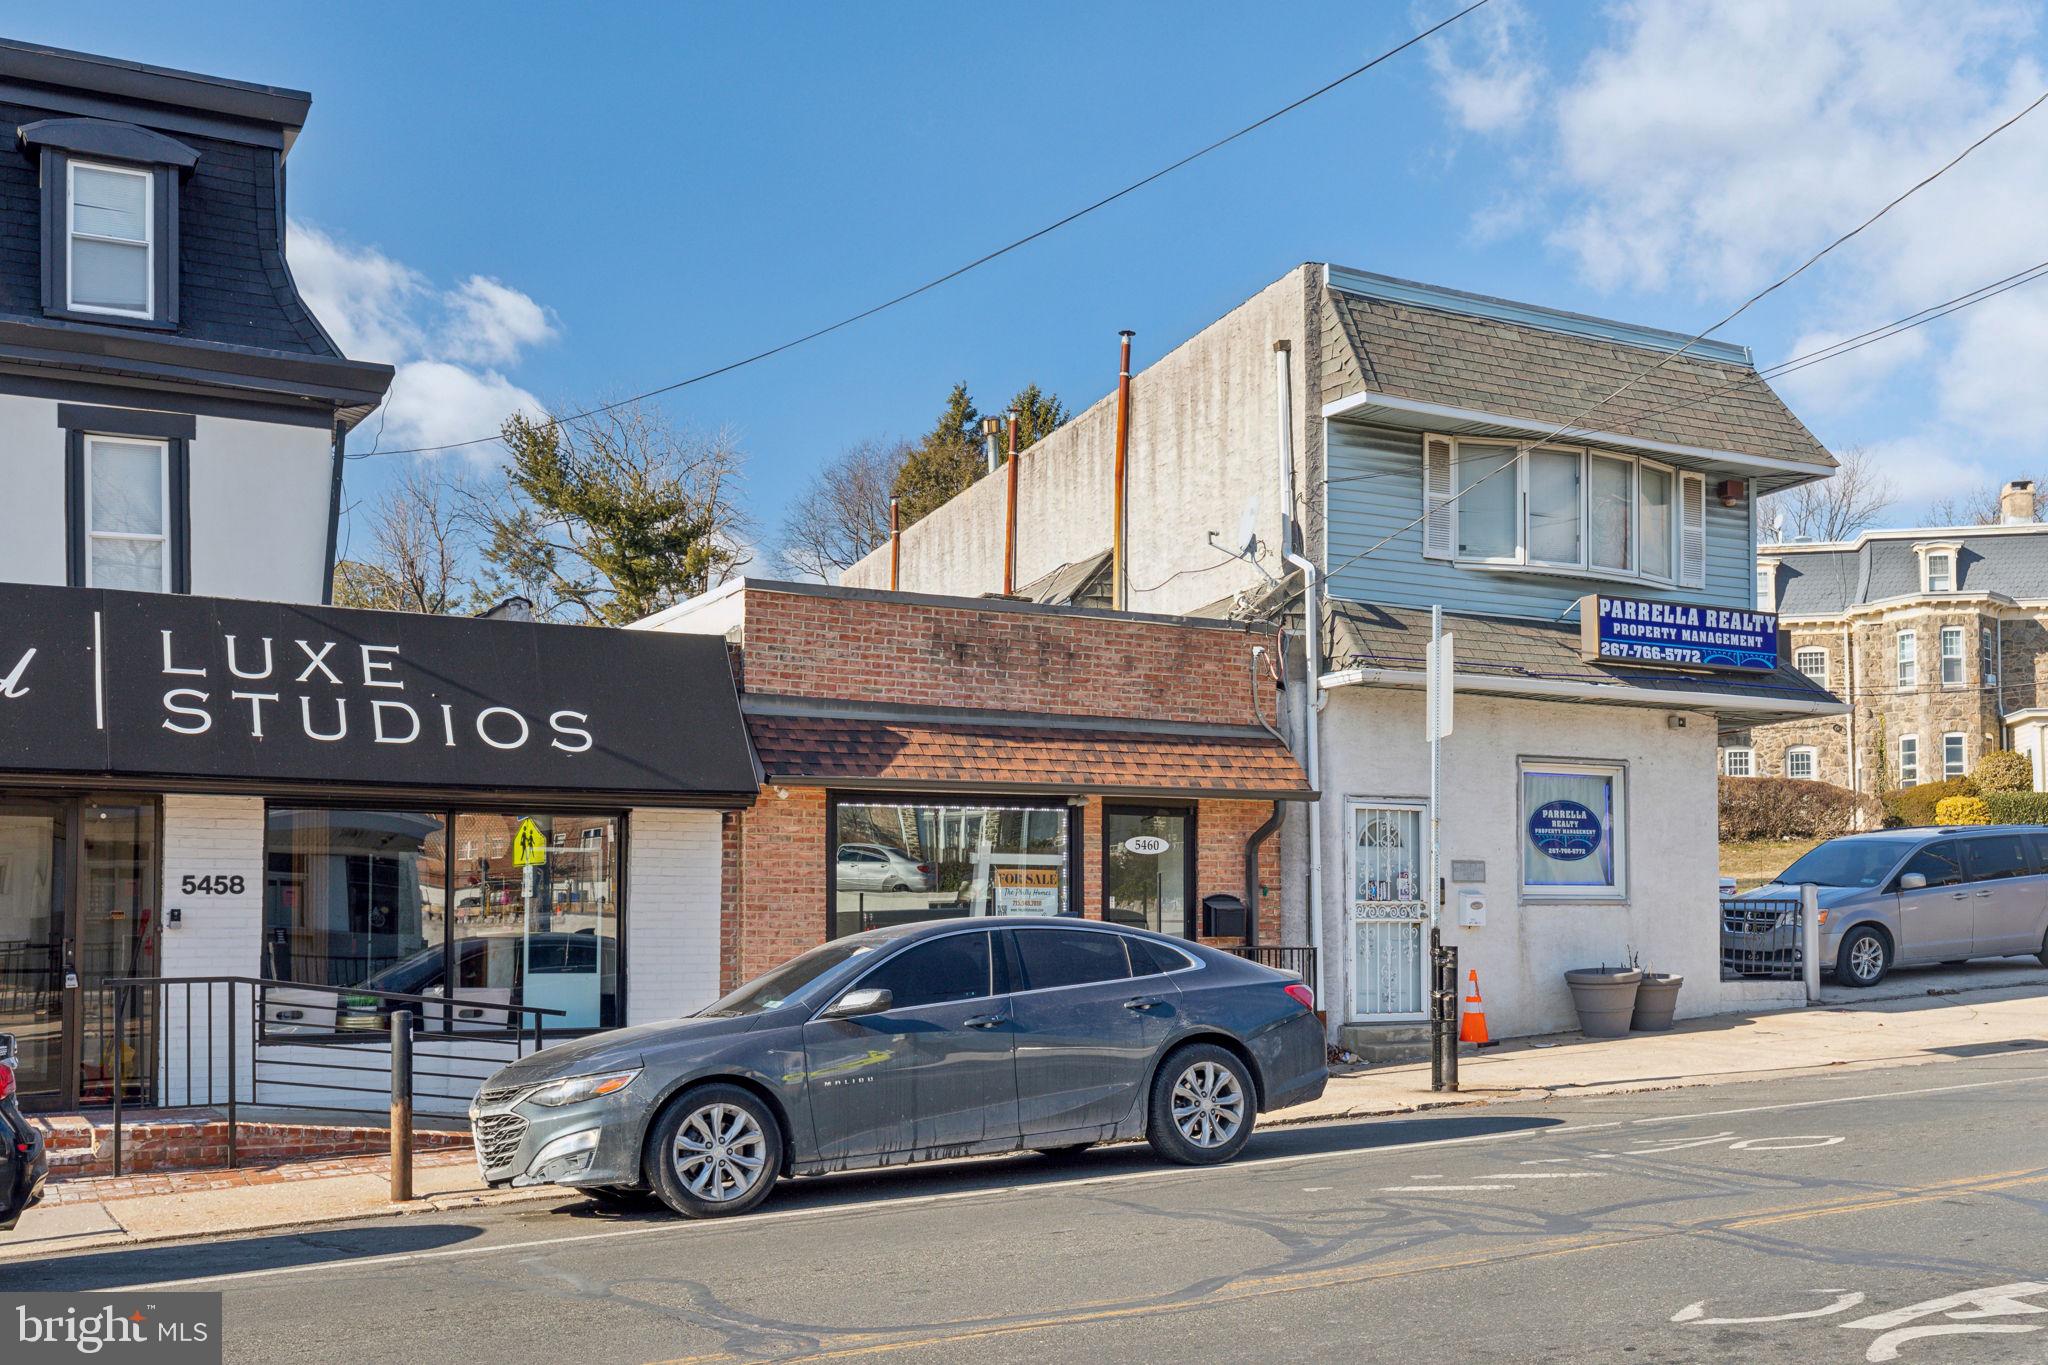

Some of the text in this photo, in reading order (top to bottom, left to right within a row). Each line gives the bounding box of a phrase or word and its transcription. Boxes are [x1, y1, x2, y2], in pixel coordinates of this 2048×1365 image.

[1600, 598, 1776, 634] PARRELLA REALTY
[1613, 623, 1763, 648] PROPERTY MANAGEMENT
[161, 630, 404, 689] LUXE
[1601, 641, 1701, 664] 267-766-5772
[162, 688, 594, 753] STUDIOS
[1542, 810, 1587, 819] PARRELLA
[1551, 820, 1579, 828] REALTY
[1134, 840, 1160, 850] 5460
[181, 874, 245, 895] 5458
[999, 873, 1057, 885] FOR SALE
[824, 1076, 874, 1087] MALIBU
